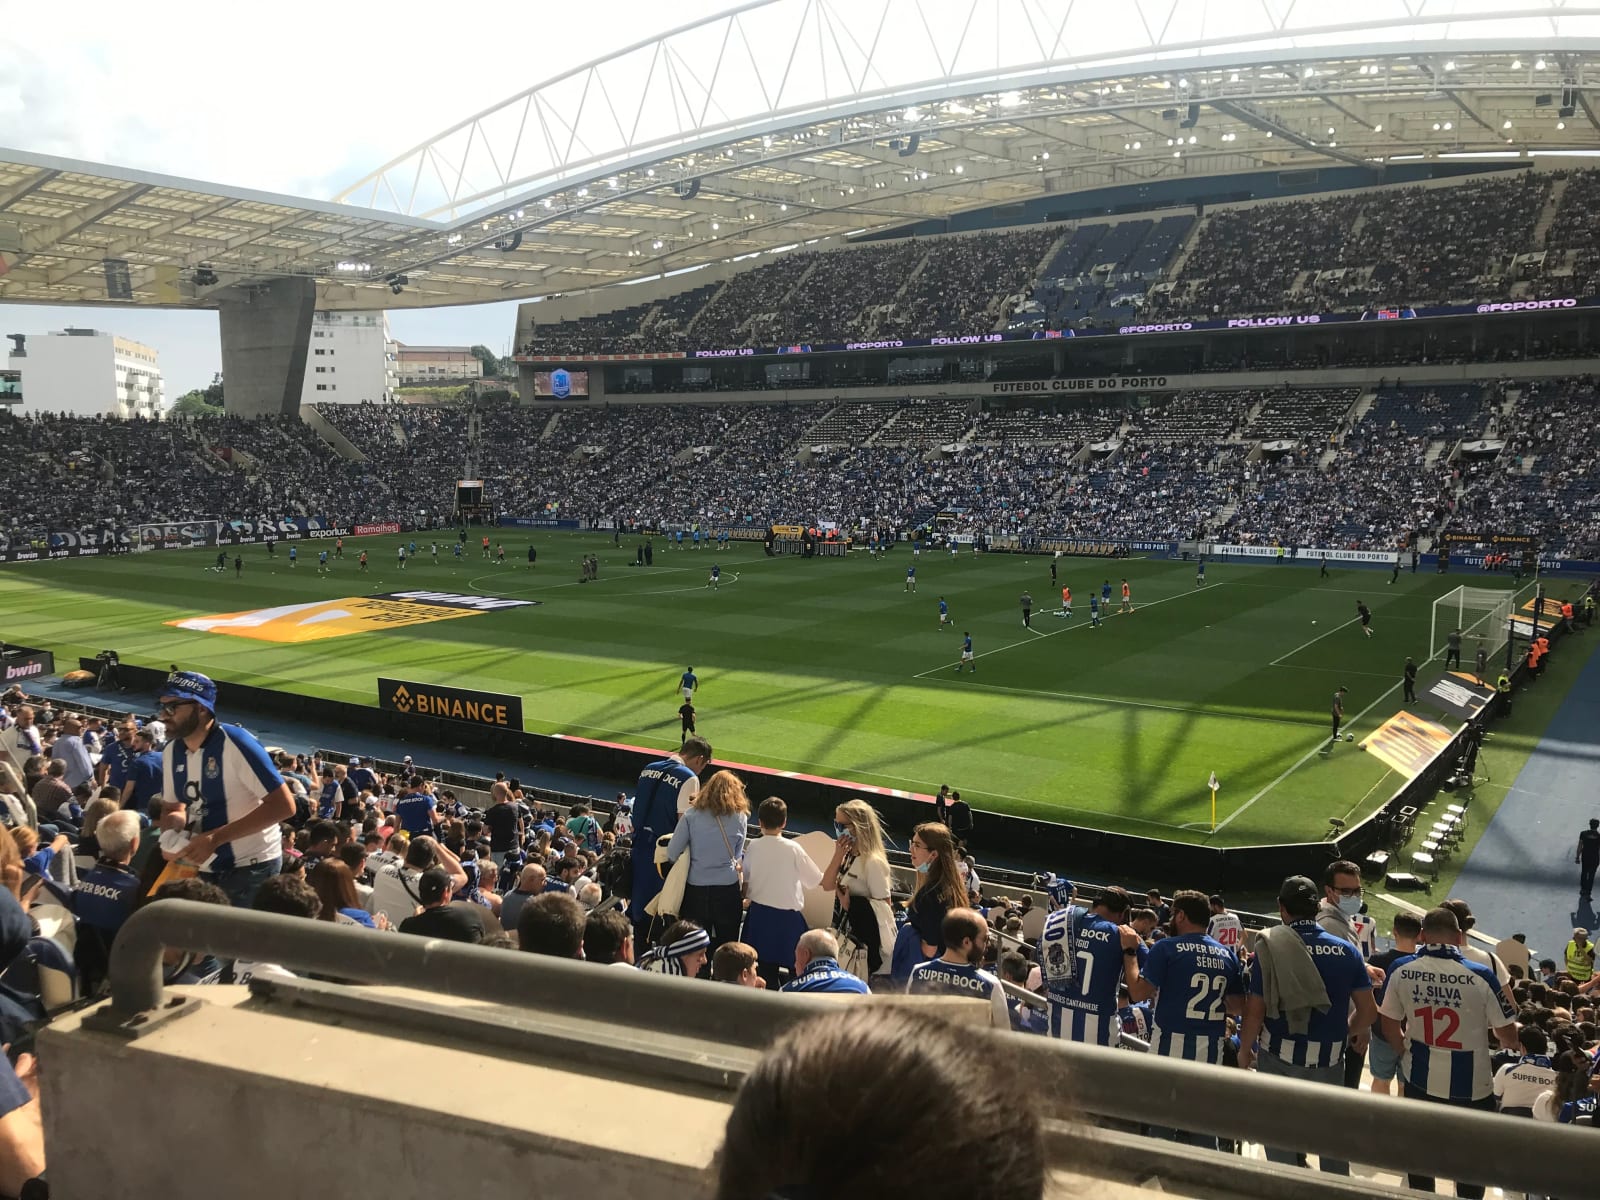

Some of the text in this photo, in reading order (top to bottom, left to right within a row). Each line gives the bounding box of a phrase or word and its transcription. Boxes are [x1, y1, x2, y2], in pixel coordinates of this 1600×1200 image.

[1477, 299, 1577, 314] @FCPORTO
[1119, 322, 1192, 335] @FCPORTO
[1228, 314, 1320, 328] FOLLOW US
[931, 334, 1003, 345] FOLLOW US
[696, 350, 737, 358] FOLLOW
[738, 348, 754, 356] US
[993, 377, 1167, 393] FUTEBOL CLUBE DO PORTO
[357, 523, 397, 534] Ramalhos
[17, 551, 38, 560] bwin
[79, 546, 99, 555] bwin
[1335, 552, 1355, 560] CLUBE
[1367, 553, 1389, 561] PORTO
[6, 660, 42, 679] bwin
[416, 694, 508, 725] BINANCE
[94, 884, 121, 901] BOCK
[1081, 928, 1111, 942] BOCK
[1218, 928, 1237, 945] 20
[1354, 923, 1364, 935] 7
[1176, 942, 1233, 960] SUPER BOCK
[1315, 945, 1346, 956] BOCK
[1196, 954, 1225, 970] SÉRGIO
[792, 971, 829, 988] SUPER
[918, 968, 985, 992] SUPER BOCK
[1076, 950, 1094, 996] 7
[1400, 969, 1475, 986] SUPER BOCK
[1185, 972, 1227, 1021] 22
[1412, 984, 1462, 1000] J. SILVA
[1414, 1005, 1463, 1050] 12
[1511, 1072, 1538, 1084] SUPER
